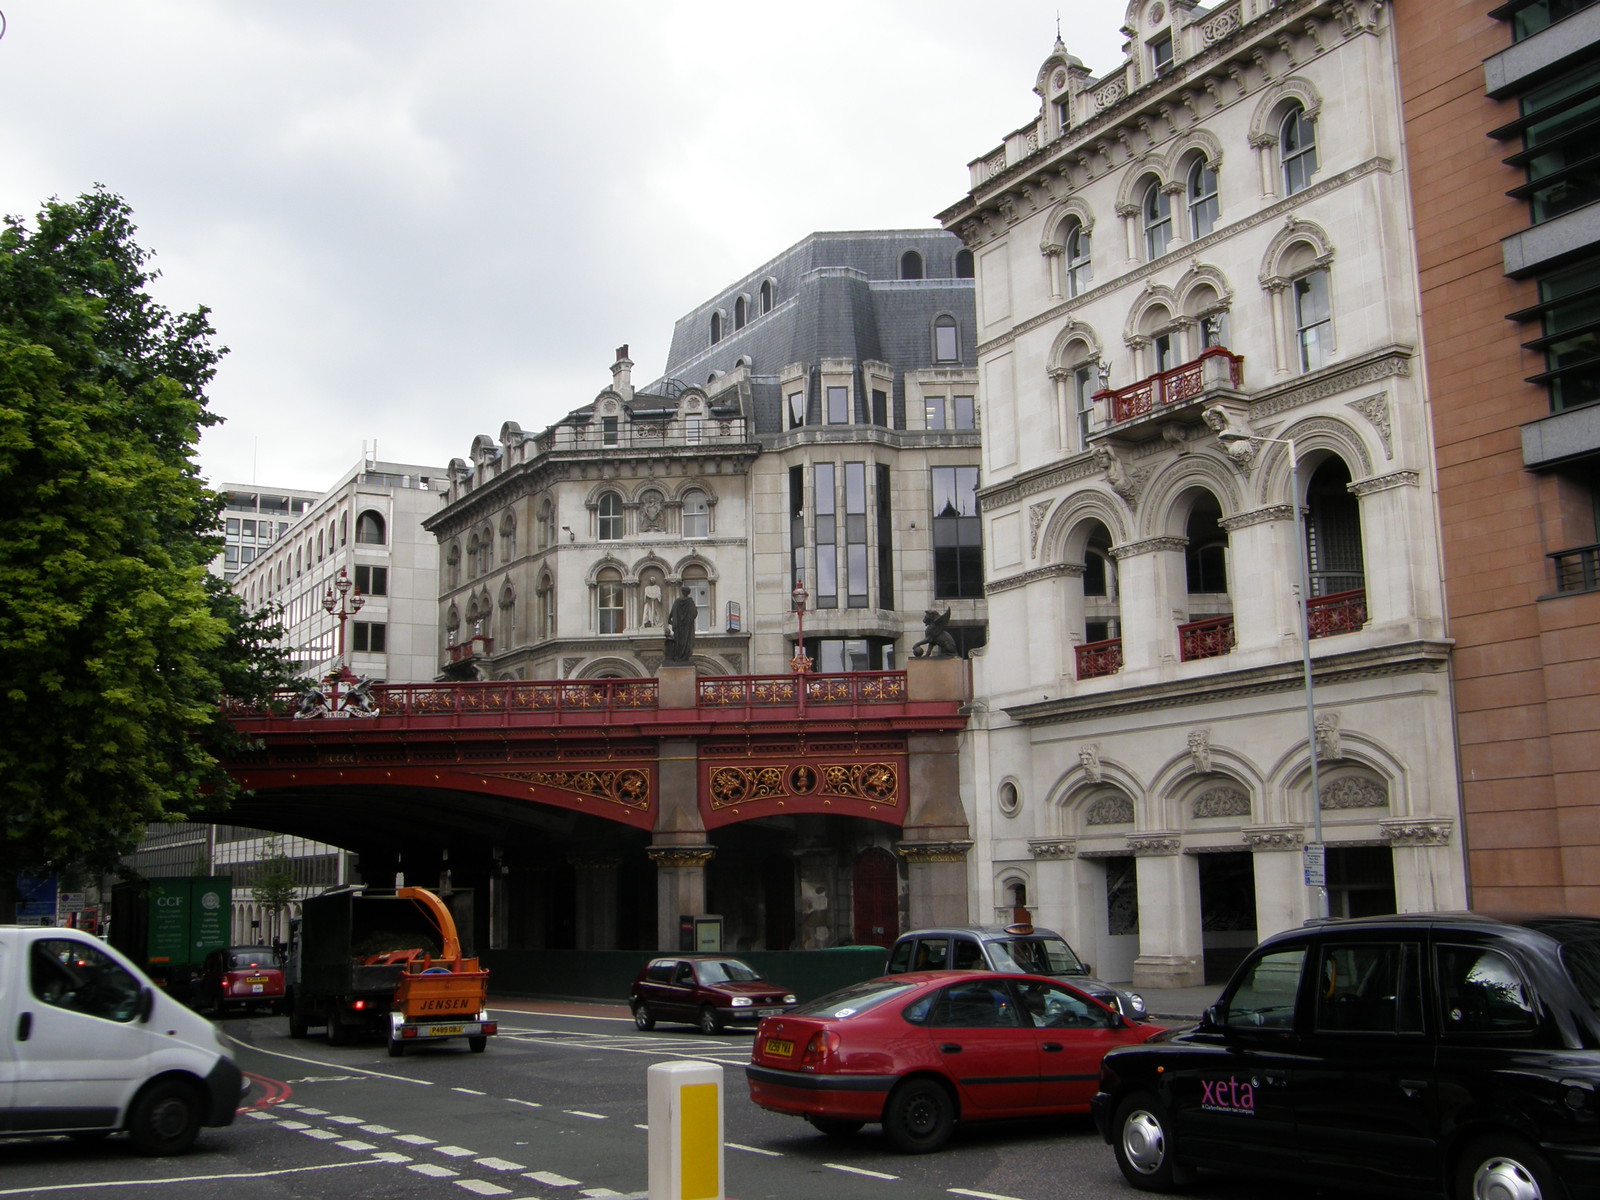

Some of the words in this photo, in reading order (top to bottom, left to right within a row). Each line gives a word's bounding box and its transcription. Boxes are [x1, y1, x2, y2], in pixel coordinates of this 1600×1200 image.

[157, 896, 184, 907] CCF
[420, 999, 469, 1010] JENSEN
[1201, 1075, 1254, 1109] xeta
